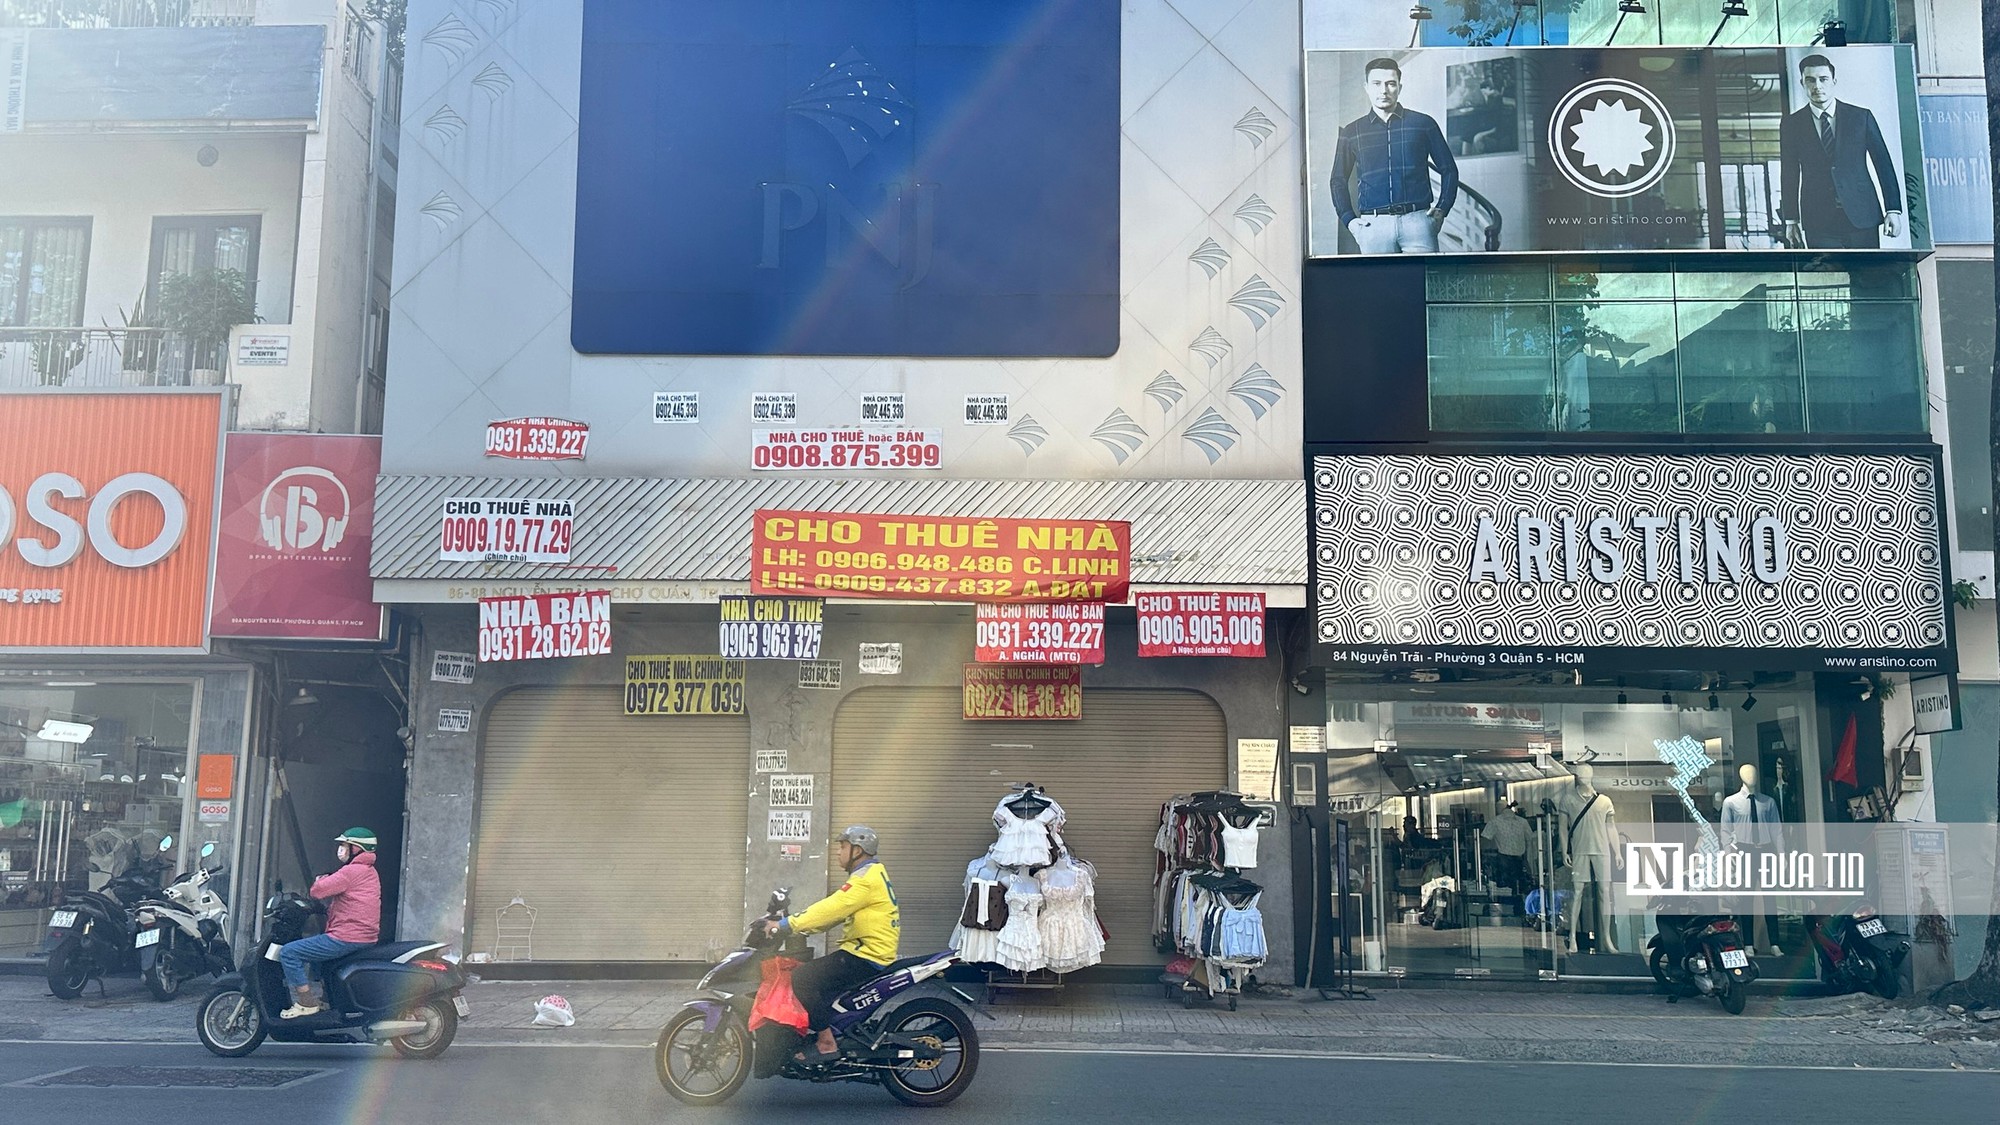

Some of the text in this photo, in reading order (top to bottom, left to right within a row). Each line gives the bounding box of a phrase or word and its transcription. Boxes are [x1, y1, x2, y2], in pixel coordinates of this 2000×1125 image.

[1937, 111, 1960, 123] BAN
[1546, 214, 1687, 225] www.aristino.com
[655, 402, 698, 418] 0902.445.338
[754, 403, 796, 419] 0902.445.338
[862, 403, 904, 419] 0902.445.338
[966, 404, 1008, 420] 0902.445.338
[485, 426, 590, 455] 0931.339.227
[769, 430, 924, 445] NHÀ CHO THUÊ hoặc BÁN
[754, 444, 940, 467] 0908.875.399
[446, 500, 572, 516] CHO THUÊ NHÀ
[0, 472, 188, 568] SO
[443, 517, 572, 554] 0909.19.77.29
[764, 518, 1119, 551] CHO THUÊ NHÀ
[1469, 517, 1787, 585] ARISTINO
[763, 548, 806, 567] LH:
[815, 550, 1013, 574] 0906.948.486
[1023, 558, 1118, 576] C.LINH
[761, 571, 805, 590] LH:
[814, 573, 1012, 597] 0909.437.832
[1022, 579, 1107, 603] A.ĐẠT
[480, 592, 610, 629] NHÀ BÁN
[720, 597, 823, 623] NHÀ CHO THUÊ
[1001, 603, 1021, 619] CHO
[1082, 602, 1104, 619] BÁN
[1138, 596, 1172, 612] CHO
[1178, 593, 1220, 612] THUÊ
[1226, 593, 1262, 613] NHÀ
[720, 623, 822, 658] 0903 963 325
[976, 621, 1104, 649] 0931.339.227
[1139, 615, 1263, 646] 0906.905.006
[479, 622, 611, 662] 0931.28.62.62
[999, 650, 1081, 663] A. NGHĨA (MTG)
[1333, 652, 1347, 662] 84
[1350, 648, 1397, 664] Nguyễn
[1435, 650, 1485, 666] Phường
[1488, 652, 1496, 663] 3
[1500, 652, 1533, 666] Quận
[1536, 653, 1544, 664] 5
[1555, 653, 1585, 664] HCM
[628, 661, 646, 680] CHO
[649, 657, 671, 680] THUÊ
[673, 657, 692, 680] NHÀ
[695, 656, 723, 680] CHÍNH
[800, 666, 815, 682] 0931
[816, 667, 829, 682] 642
[965, 667, 982, 680] CHO
[626, 682, 743, 713] 0972 377 039
[965, 684, 1080, 717] 0922.16.36.36
[1916, 694, 1949, 714] ARISTINO
[772, 778, 784, 787] CHO
[201, 806, 228, 814] GOSO
[854, 992, 882, 1010] LIFE
